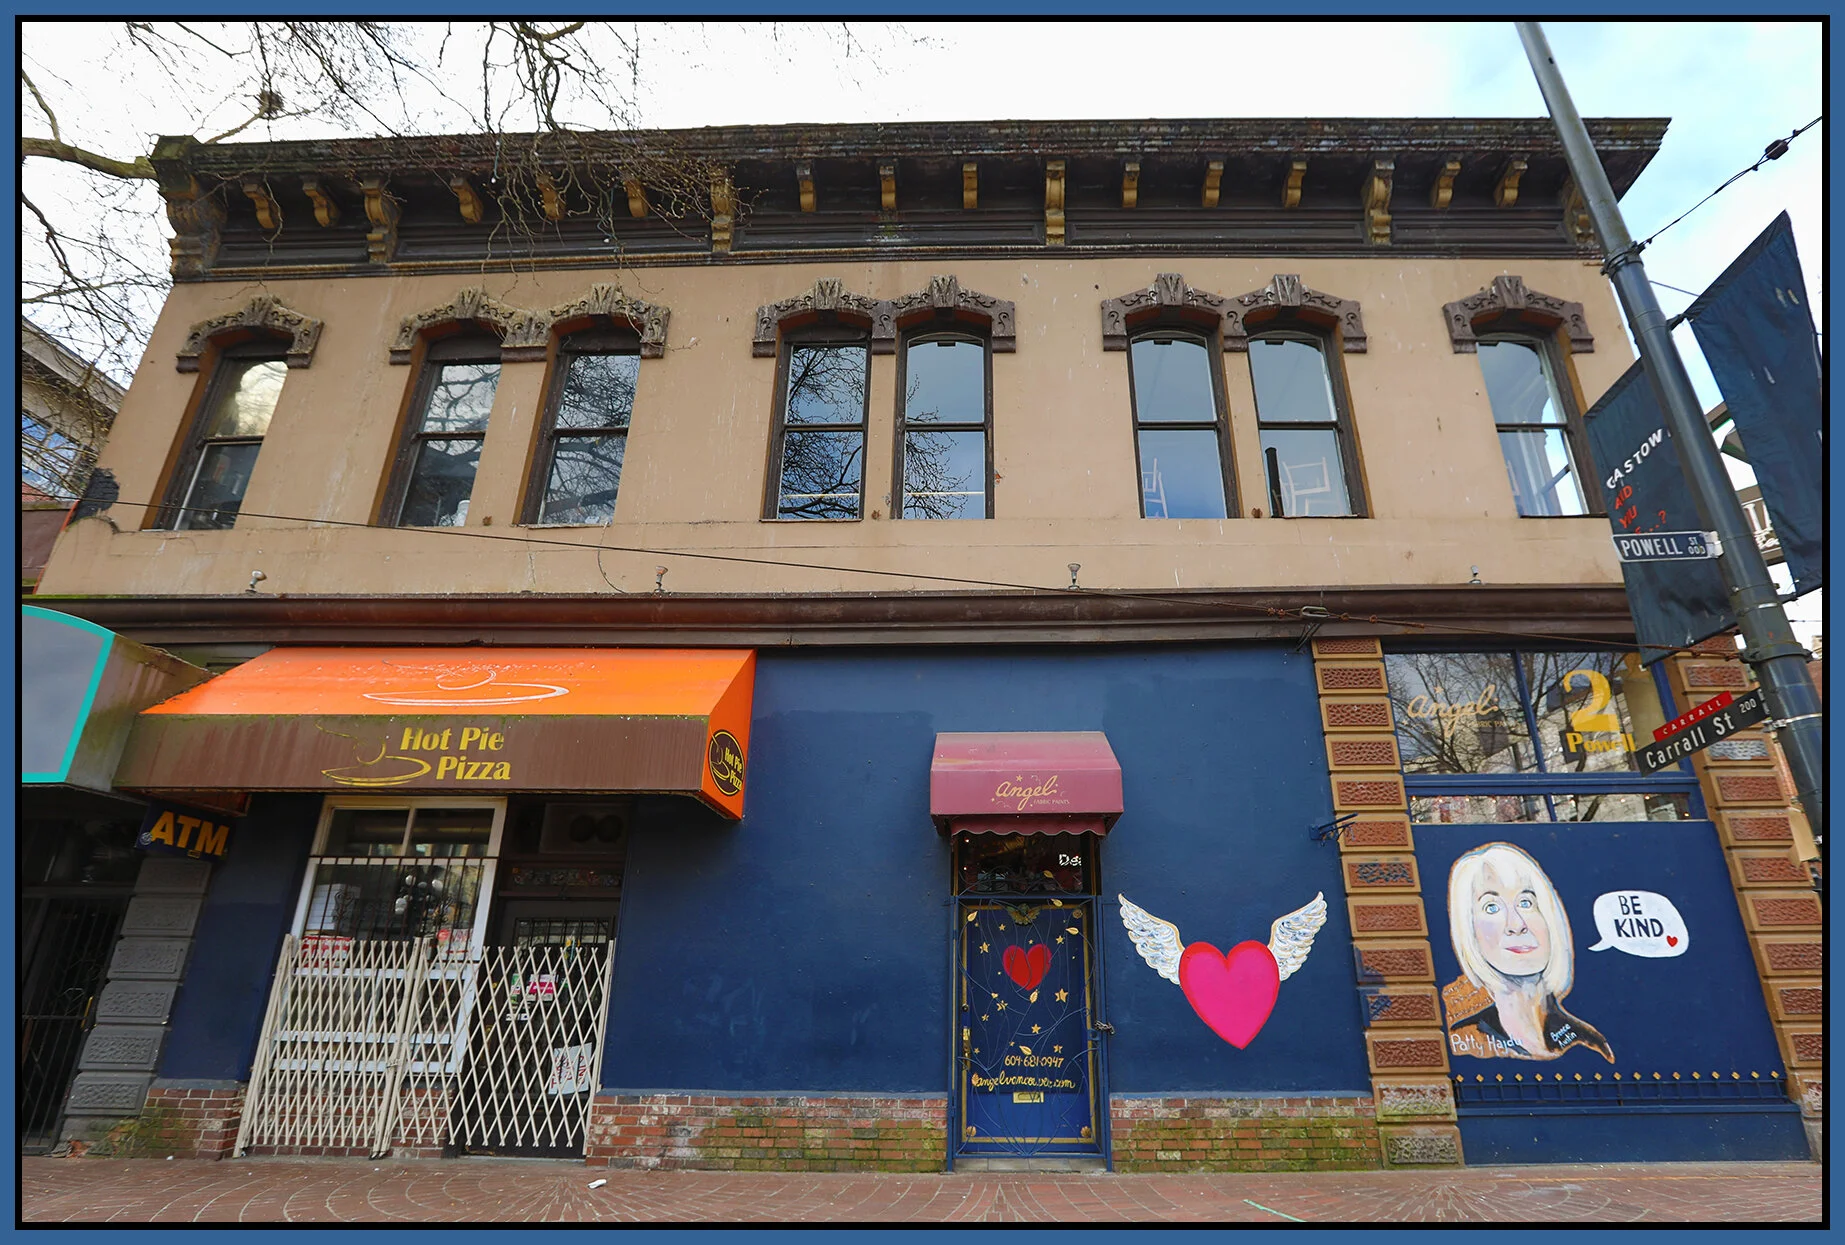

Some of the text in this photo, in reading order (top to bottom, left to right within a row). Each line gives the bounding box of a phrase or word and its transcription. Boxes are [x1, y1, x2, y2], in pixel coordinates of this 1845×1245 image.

[1620, 536, 1699, 557] POWELL ST
[1563, 669, 1621, 732] 2
[1662, 700, 1722, 735] CARRALL
[400, 727, 504, 751] Hot Pie
[1565, 732, 1637, 753] Powell
[1646, 698, 1757, 769] Carrall St 200
[436, 755, 511, 780] Pizza
[725, 747, 742, 773] Hot Pie
[150, 810, 230, 856] ATM
[1618, 895, 1643, 915] BE
[1614, 918, 1664, 938] KIND
[1450, 1033, 1523, 1056] Patty Hajdu
